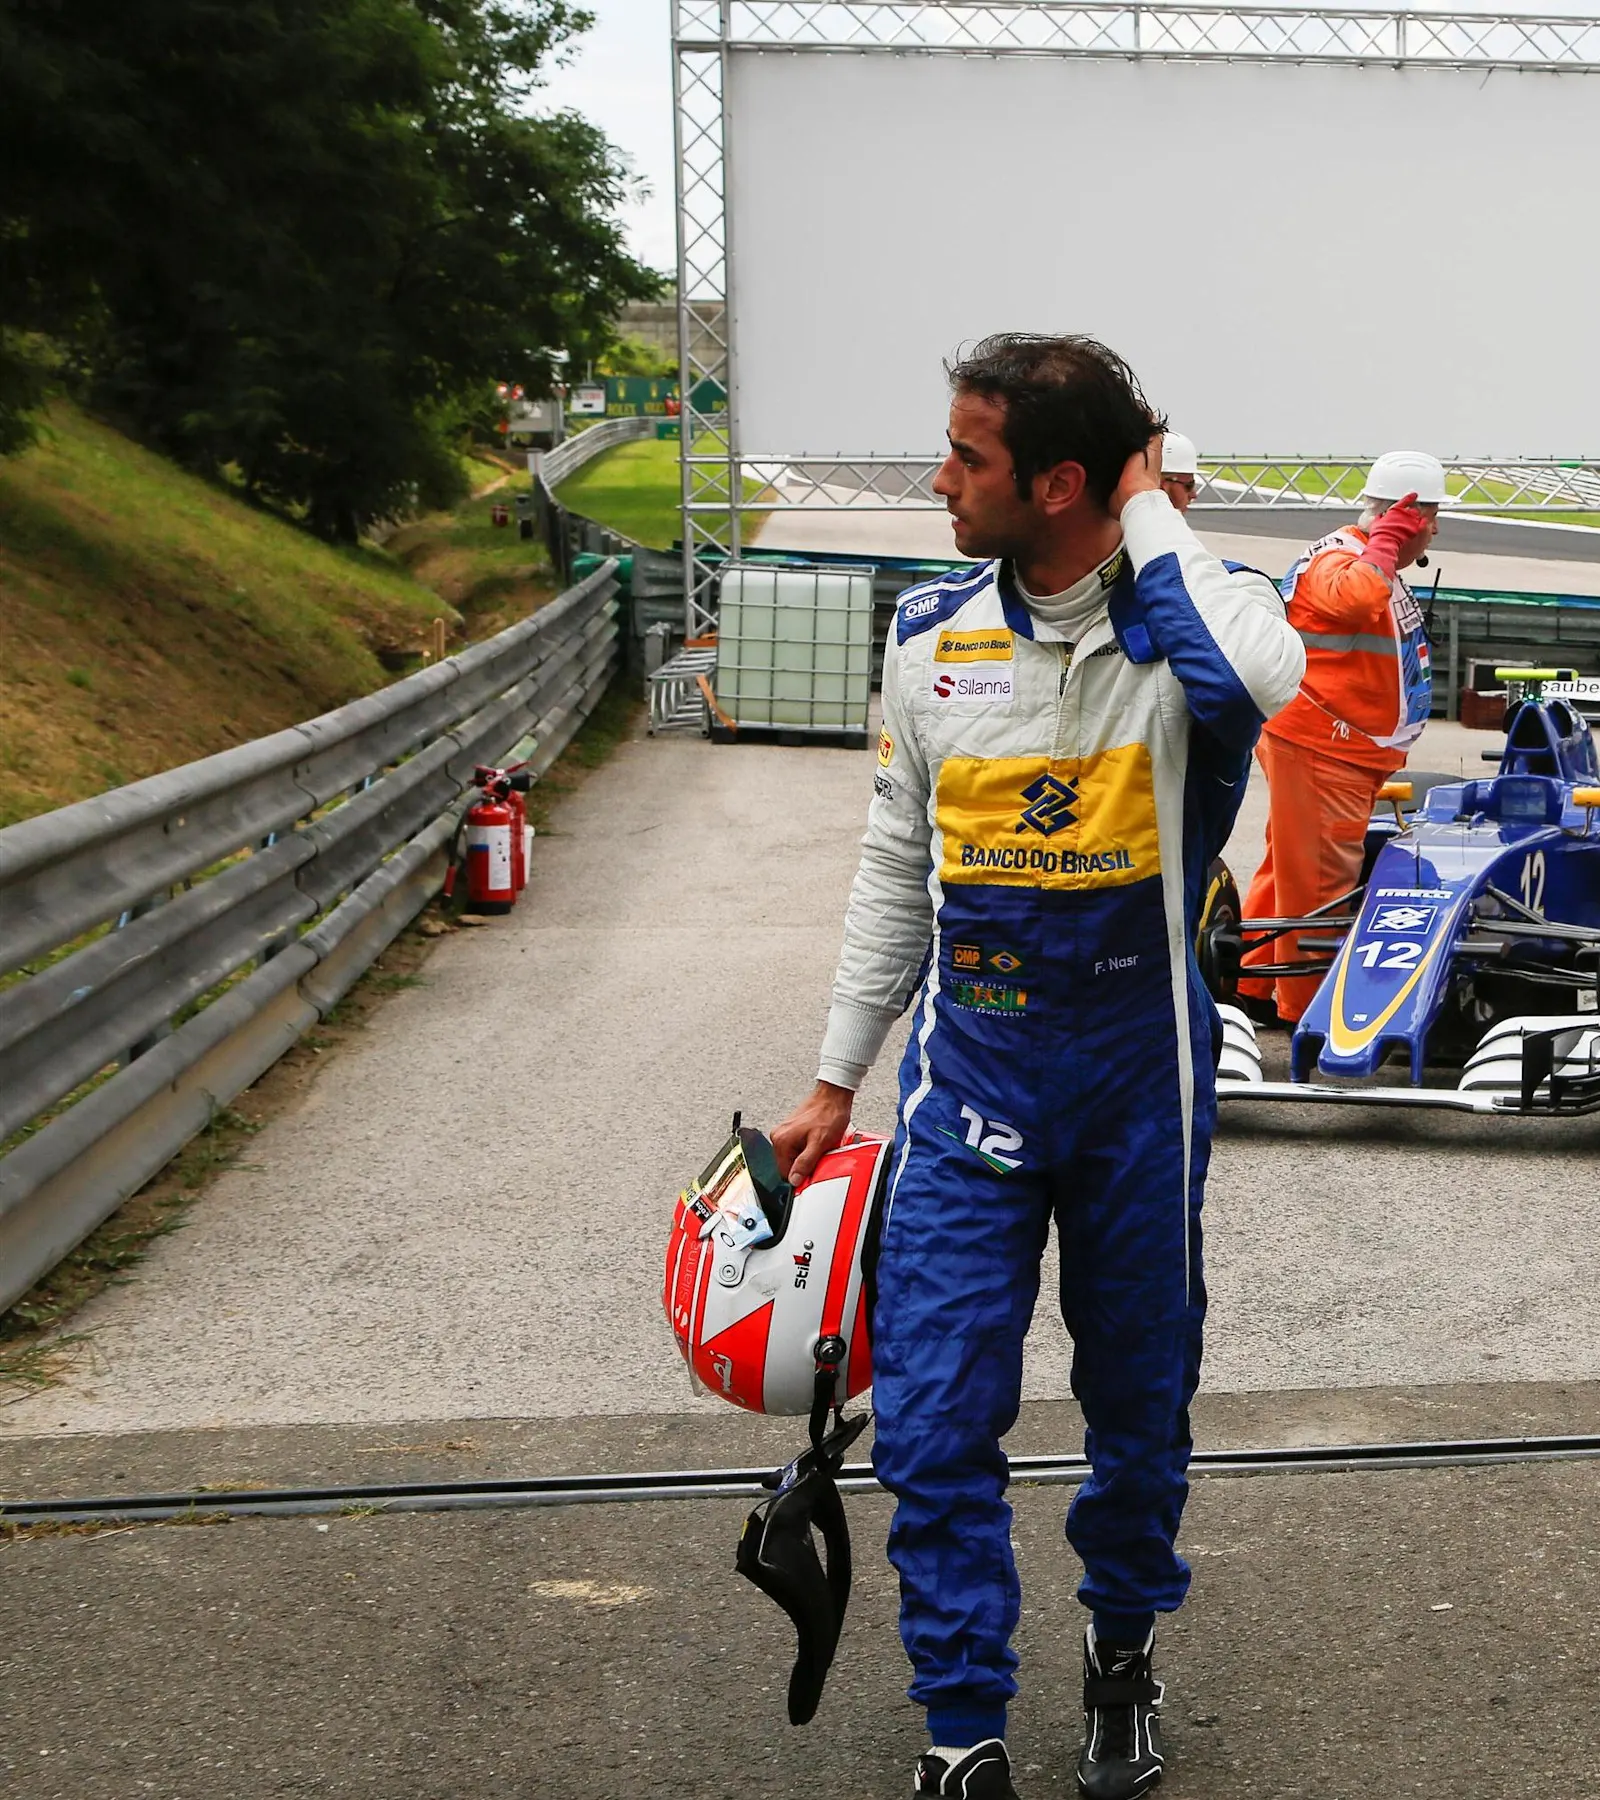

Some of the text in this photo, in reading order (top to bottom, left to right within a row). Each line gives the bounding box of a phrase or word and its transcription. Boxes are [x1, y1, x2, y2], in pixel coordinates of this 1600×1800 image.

[905, 596, 940, 617] OMP
[954, 641, 978, 651] BANCO
[979, 641, 990, 650] DO
[957, 679, 1011, 696] Silanna
[961, 844, 1136, 874] BANCO DO BRASIL
[1521, 849, 1546, 918] 12
[954, 948, 980, 965] OMP
[1094, 954, 1139, 975] F. Nasr
[1355, 941, 1423, 969] 12
[960, 1103, 1024, 1169] 12
